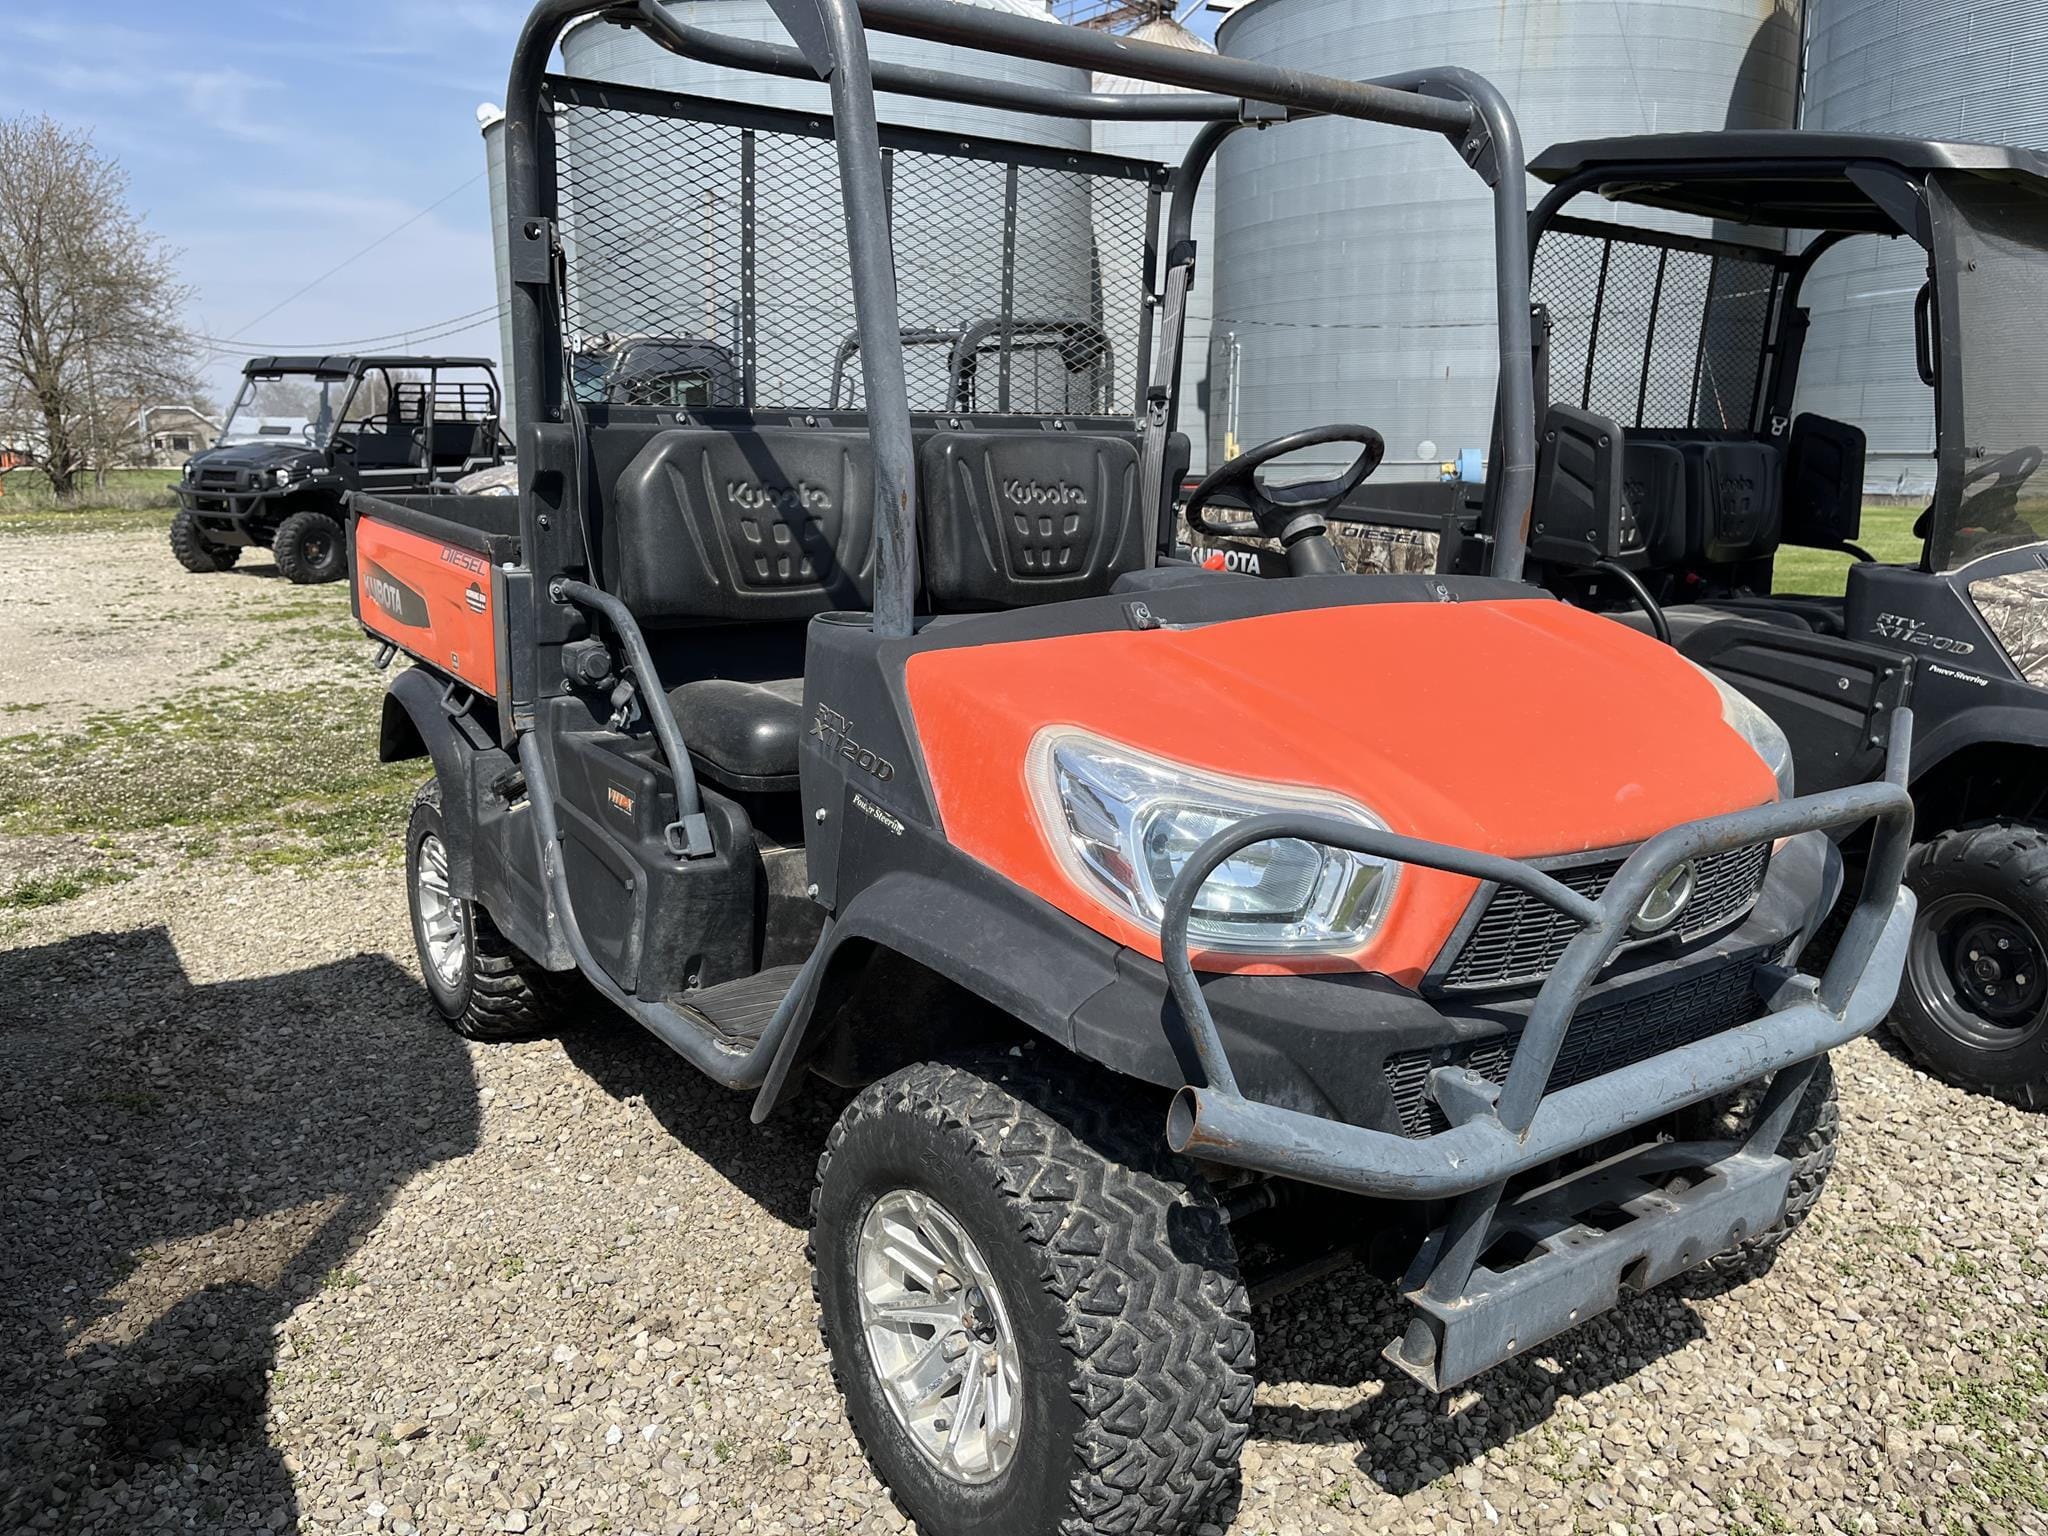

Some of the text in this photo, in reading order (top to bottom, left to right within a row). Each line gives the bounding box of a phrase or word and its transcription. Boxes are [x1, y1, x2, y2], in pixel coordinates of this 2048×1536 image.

[727, 480, 832, 510] Kubota
[1003, 479, 1087, 506] Kubota
[1342, 526, 1426, 546] DIESEL
[440, 546, 486, 576] DIESEL
[363, 574, 403, 616] KUBOTA
[1876, 612, 1926, 629] RTV
[1869, 622, 1976, 655] X1120D
[1928, 664, 1989, 687] Power Steering
[816, 702, 854, 734] RTV
[808, 717, 895, 782] X1120D
[873, 808, 905, 836] Steering
